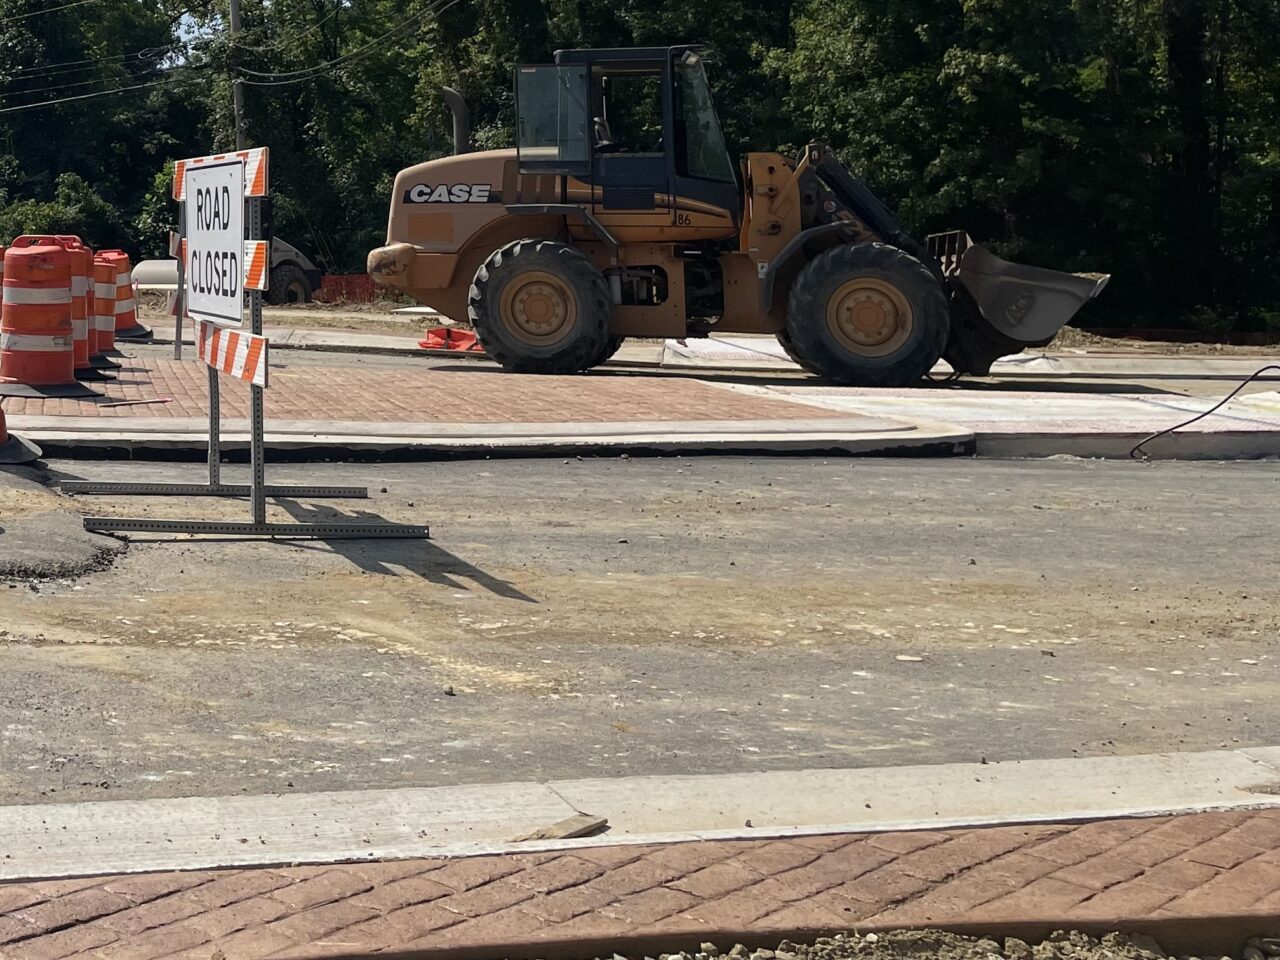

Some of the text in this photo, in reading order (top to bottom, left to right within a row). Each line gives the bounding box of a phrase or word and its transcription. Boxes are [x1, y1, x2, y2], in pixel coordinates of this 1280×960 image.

[196, 186, 230, 231] ROAD
[410, 184, 491, 203] CASE
[191, 249, 238, 298] CLOSED
